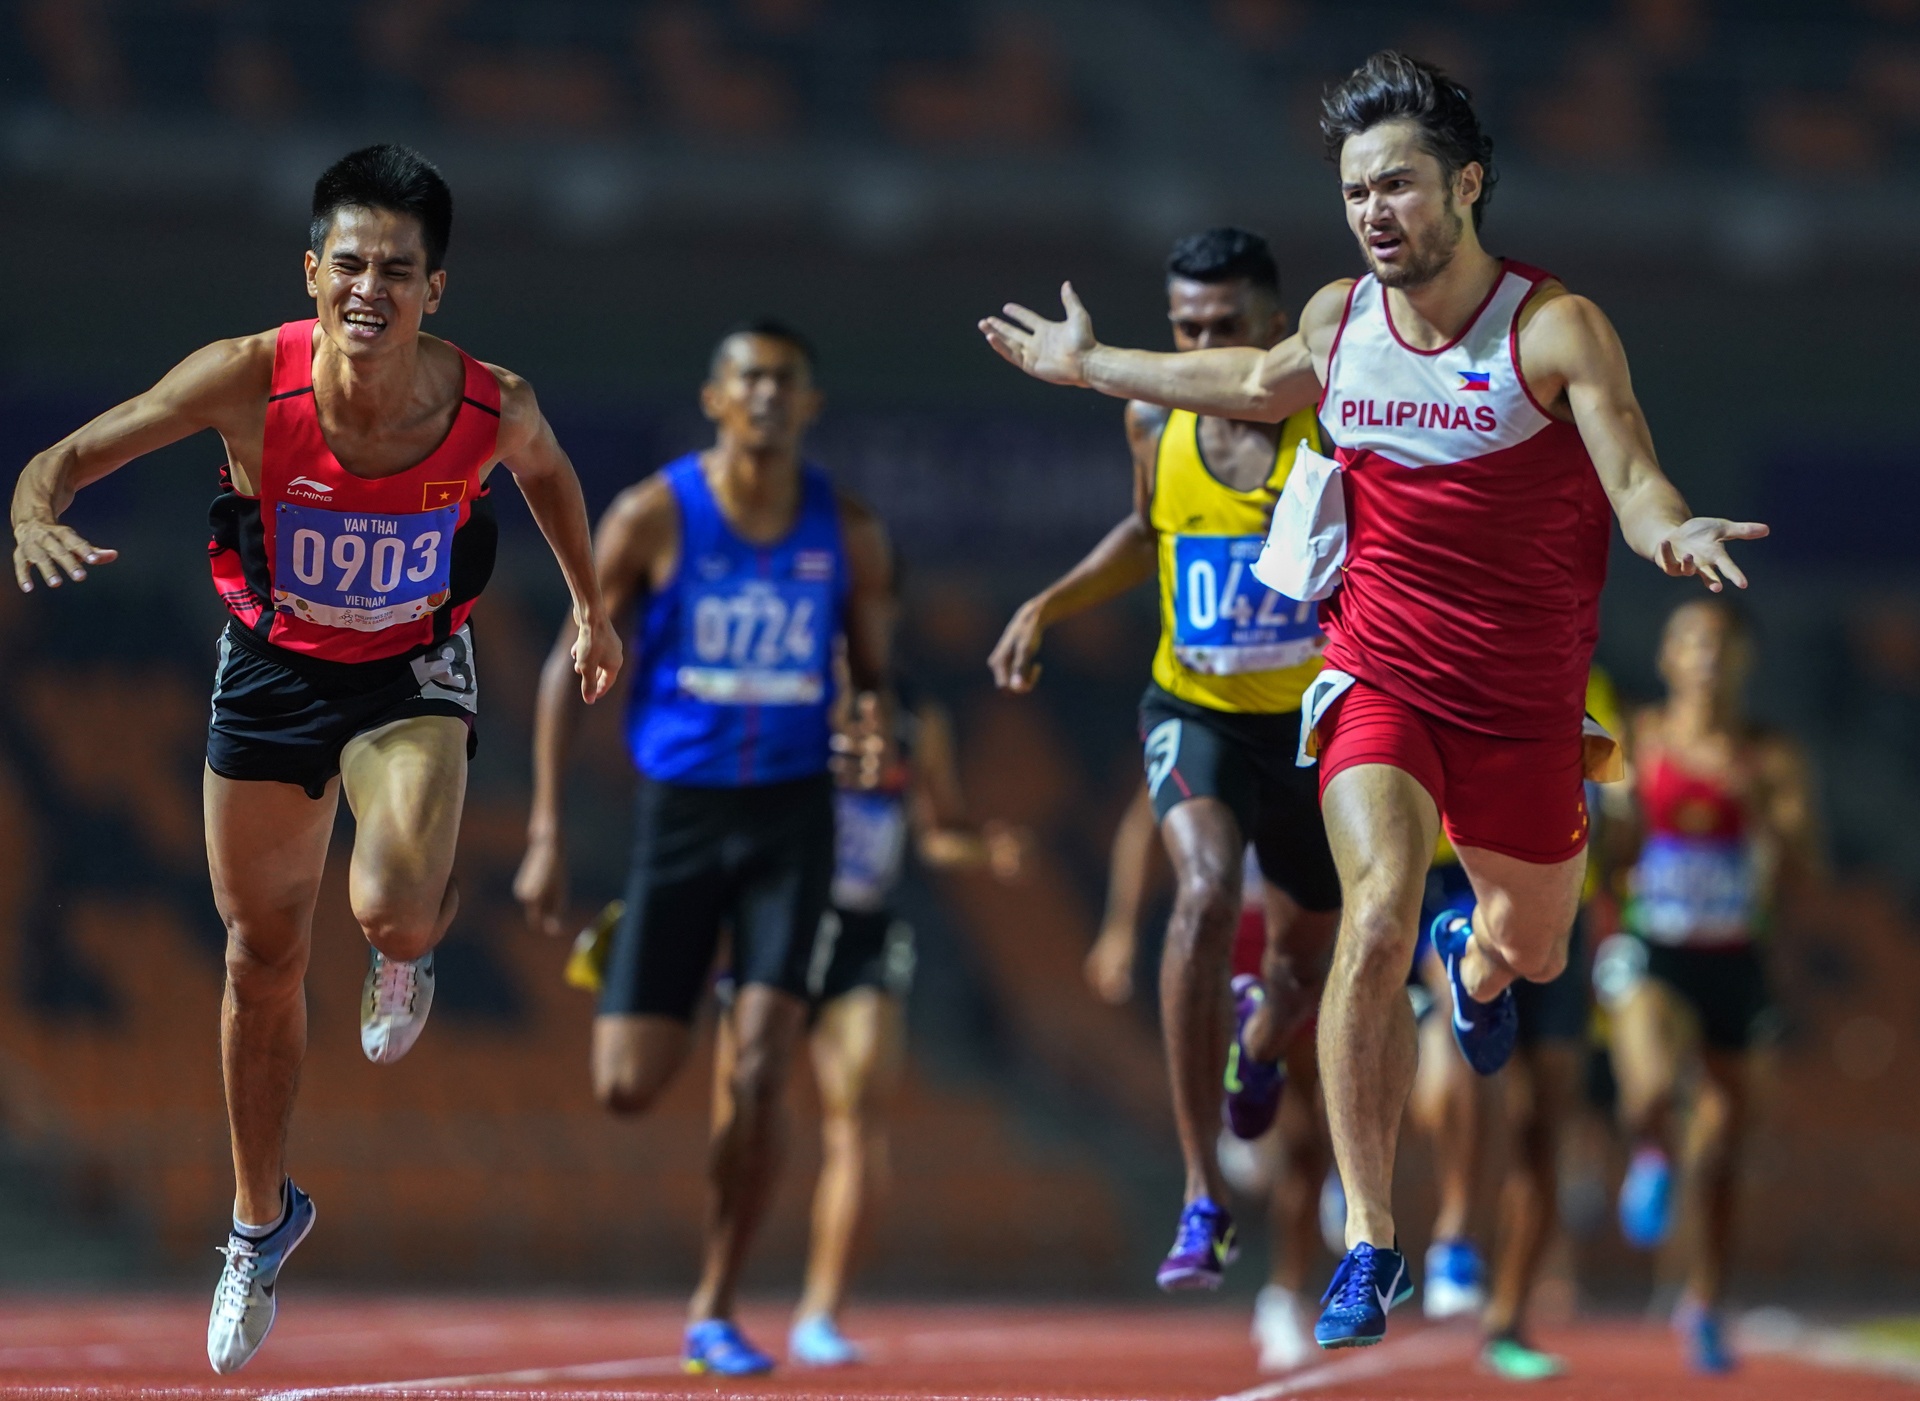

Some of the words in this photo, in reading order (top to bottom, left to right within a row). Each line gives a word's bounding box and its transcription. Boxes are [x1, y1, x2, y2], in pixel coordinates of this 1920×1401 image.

[1341, 400, 1497, 432] PILIPINAS
[286, 487, 333, 502] LI-NING
[344, 518, 368, 533] VAN
[371, 519, 398, 535] THAI
[292, 528, 442, 593] 0903
[345, 595, 387, 608] VIETNAM
[693, 595, 815, 666] 0724
